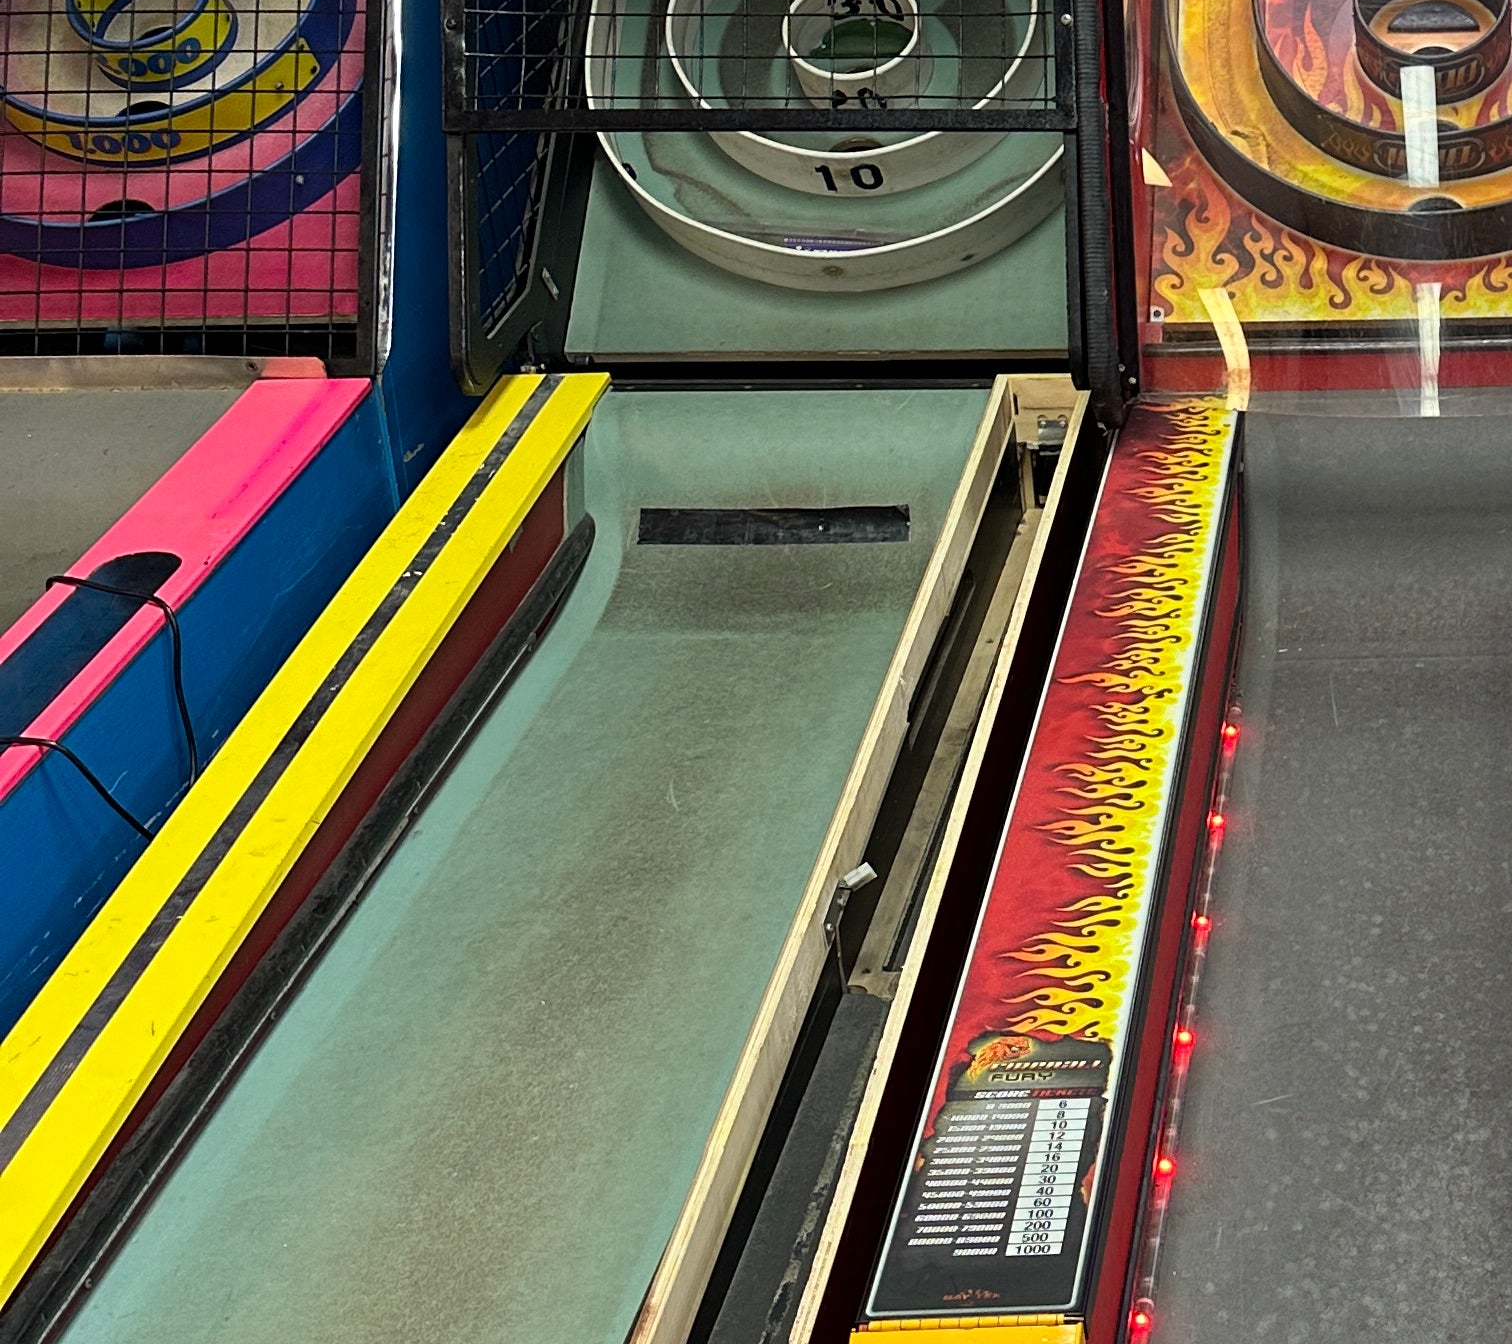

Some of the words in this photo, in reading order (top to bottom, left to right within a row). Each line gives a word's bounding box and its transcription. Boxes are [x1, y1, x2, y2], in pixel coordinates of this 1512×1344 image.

[813, 161, 885, 193] 10
[991, 1071, 1053, 1082] FURY
[974, 1089, 1031, 1099] SCORE
[1059, 1100, 1067, 1109] 6
[1056, 1110, 1064, 1119] 8
[1051, 1120, 1067, 1129] 10
[1050, 1131, 1065, 1140] 12
[1048, 1142, 1063, 1151] 14
[1045, 1153, 1060, 1162] 16
[1041, 1164, 1058, 1173] 20
[1039, 1175, 1056, 1184] 30
[1036, 1186, 1053, 1195] 40
[1034, 1198, 1051, 1207] 60
[1027, 1209, 1053, 1219] 100
[1025, 1221, 1050, 1230] 200
[1022, 1233, 1048, 1242] 500
[1015, 1244, 1049, 1254] 1000
